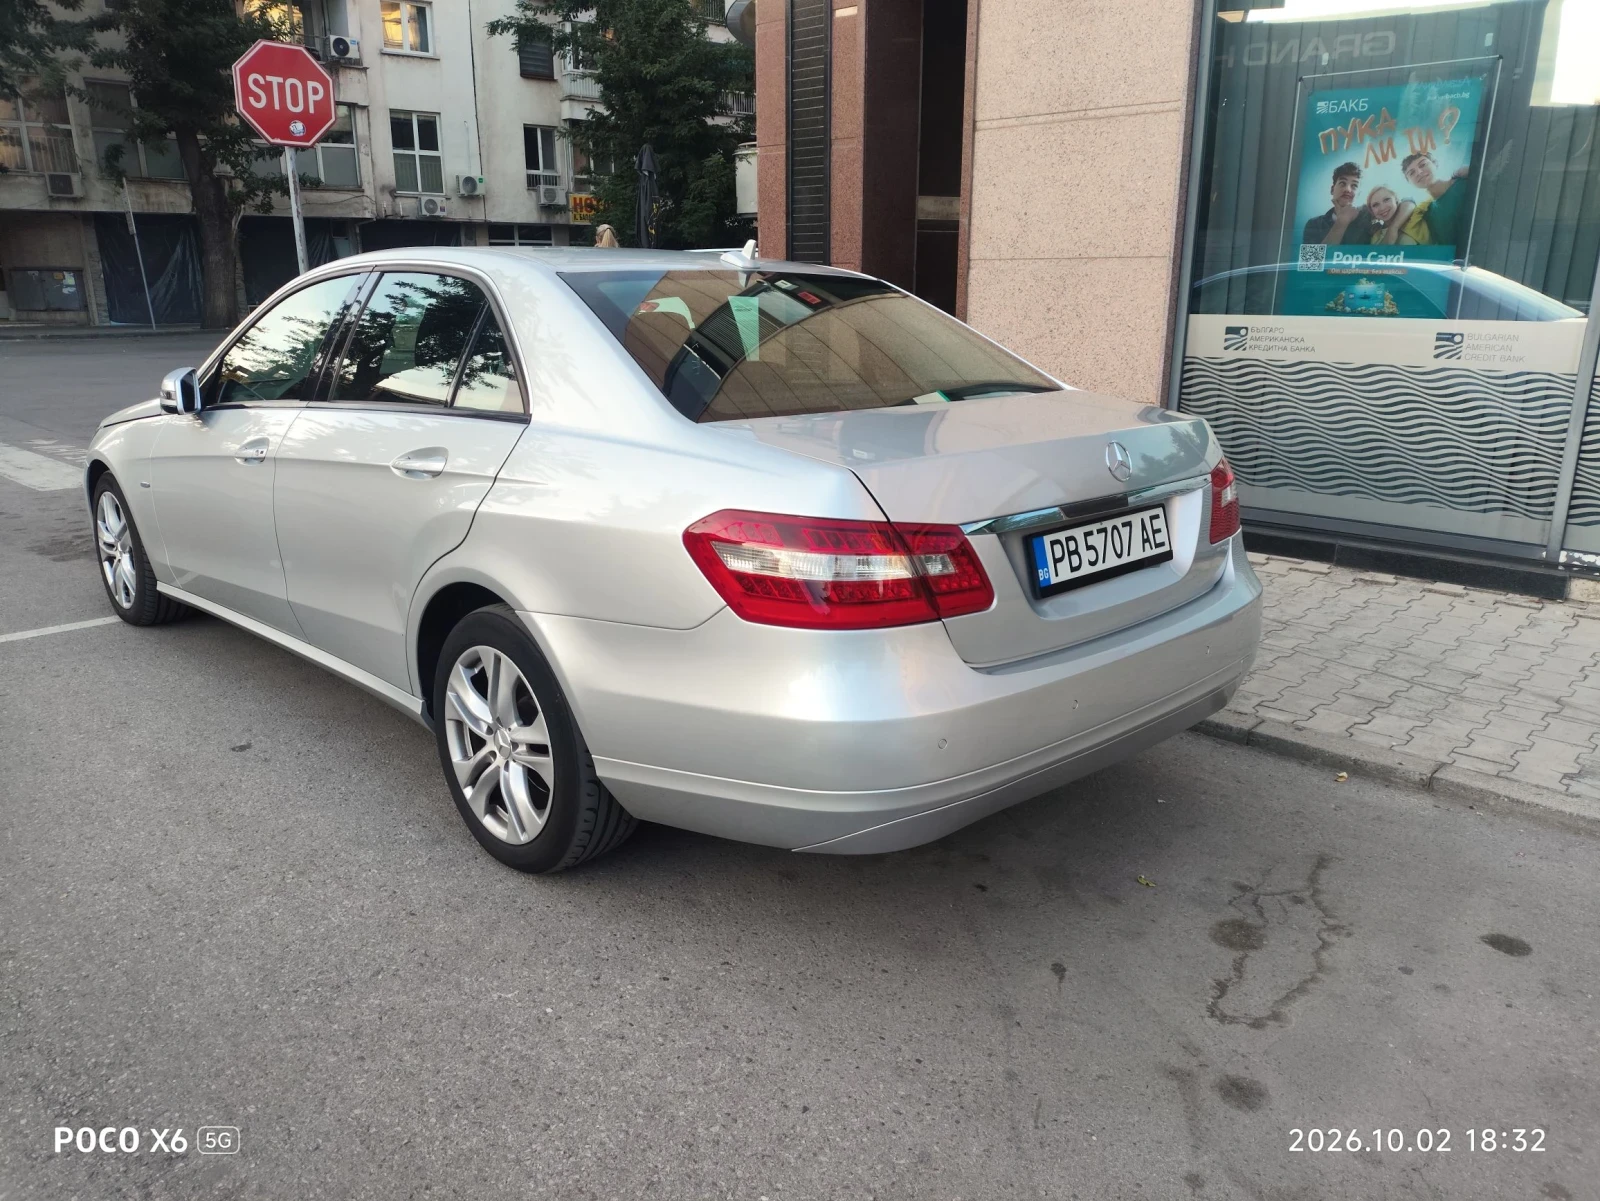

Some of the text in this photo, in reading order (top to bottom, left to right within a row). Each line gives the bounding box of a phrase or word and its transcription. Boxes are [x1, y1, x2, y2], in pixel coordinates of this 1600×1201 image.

[247, 73, 324, 114] STOP
[1329, 98, 1369, 113] БАКБ
[1318, 107, 1397, 155] ПУКА
[1364, 137, 1397, 168] ЛИ
[1332, 251, 1405, 268] Pop Card
[1250, 326, 1285, 334] БЪЛГАРО
[1249, 335, 1305, 343] АМЕРИКАНСКА
[1467, 333, 1520, 342] BULGARIAN
[1248, 344, 1288, 352] КРЕДИТНА
[1465, 343, 1513, 352] AMERICAN
[1464, 353, 1526, 363] CREDIT BANK
[1140, 514, 1166, 552] AE
[1038, 568, 1049, 581] BG
